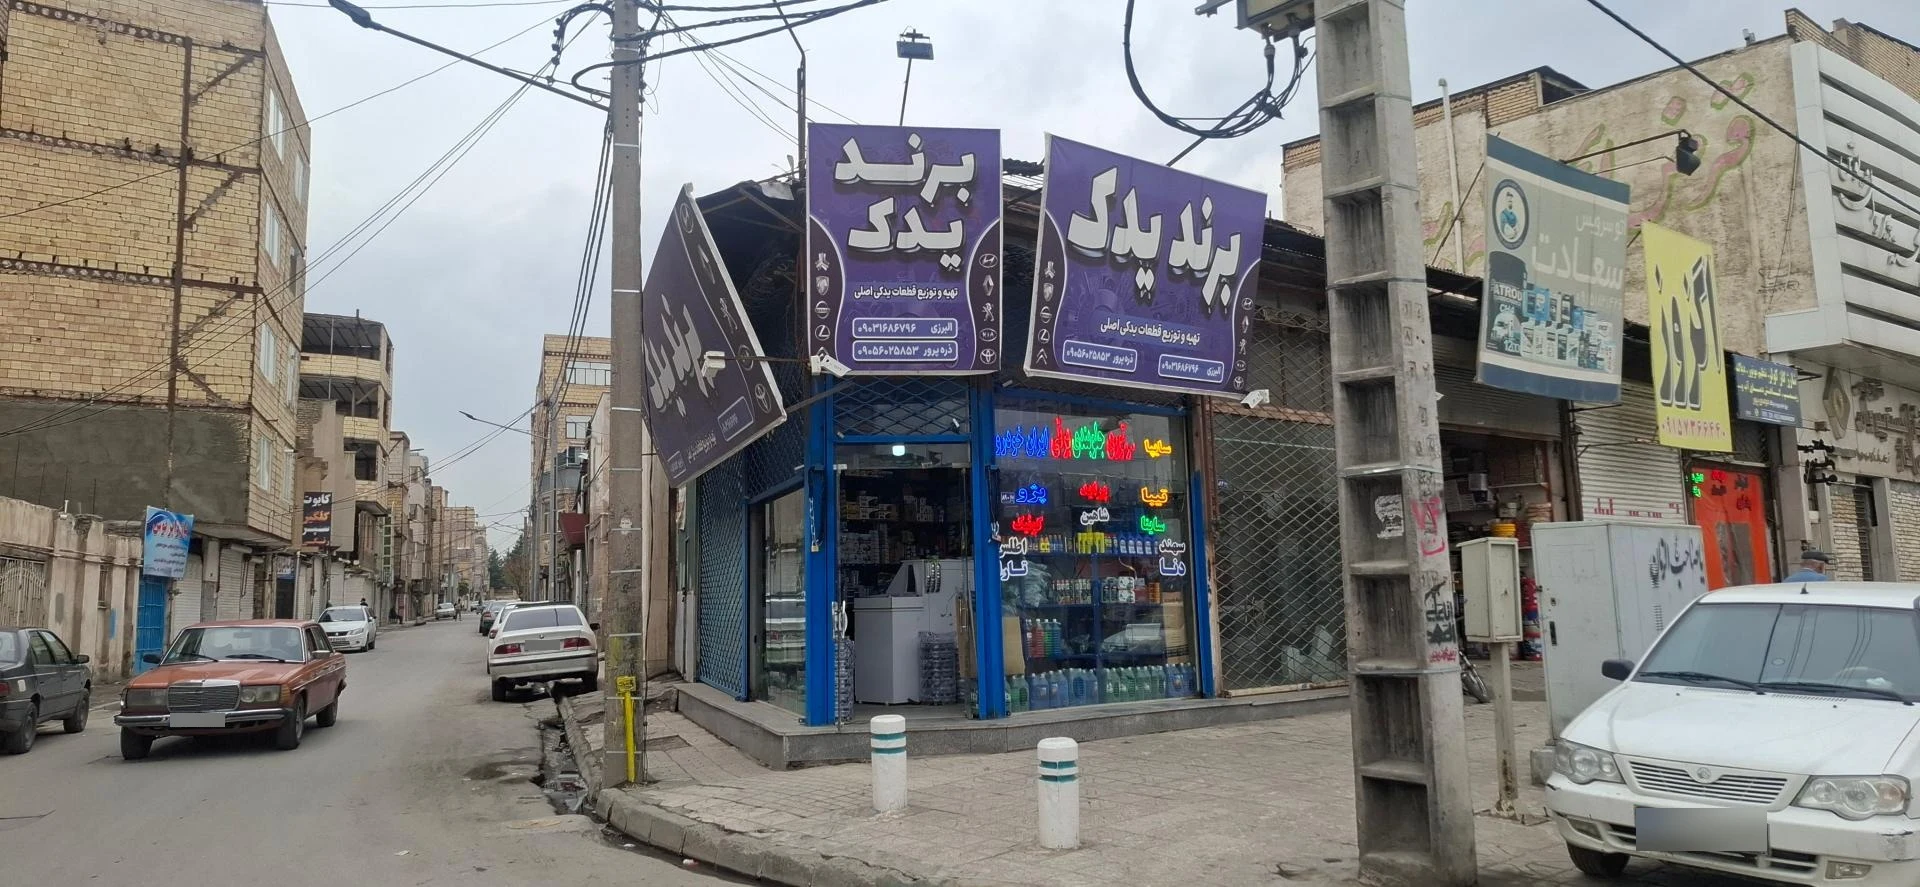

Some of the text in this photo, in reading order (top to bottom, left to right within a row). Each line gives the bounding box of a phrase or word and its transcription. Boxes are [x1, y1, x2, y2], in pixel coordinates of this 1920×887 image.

[834, 133, 975, 203] برند
[847, 197, 963, 269] یدک
[1067, 167, 1241, 306] برند یدک
[1531, 233, 1624, 291] سعادت
[854, 285, 958, 300] تهیه و توزیع قطعات یدکی اصلی
[857, 322, 953, 334] البرزی ۰۹۰۳۱۶۸۶۷۹۶
[1100, 317, 1200, 345] تهیه و توزیع قطعات یدکی اصلی
[1655, 254, 1721, 411] اگزوز
[661, 294, 716, 398] برند
[857, 344, 953, 357] ذره پرور ۰۹۰۵۶۰۲۵۸۵۳
[996, 425, 1024, 457] خودرو
[1026, 426, 1049, 457] ایران
[1143, 438, 1172, 458] سایپا
[303, 493, 331, 507] کاپوت
[1015, 483, 1047, 505] پژو
[1140, 486, 1168, 507] تیبا
[1080, 506, 1110, 526] شاهین
[1140, 515, 1166, 535] ساینا
[302, 527, 330, 536] سپر
[999, 536, 1027, 559] اطلس
[1159, 538, 1186, 555] سهند
[1159, 556, 1187, 576] دنا
